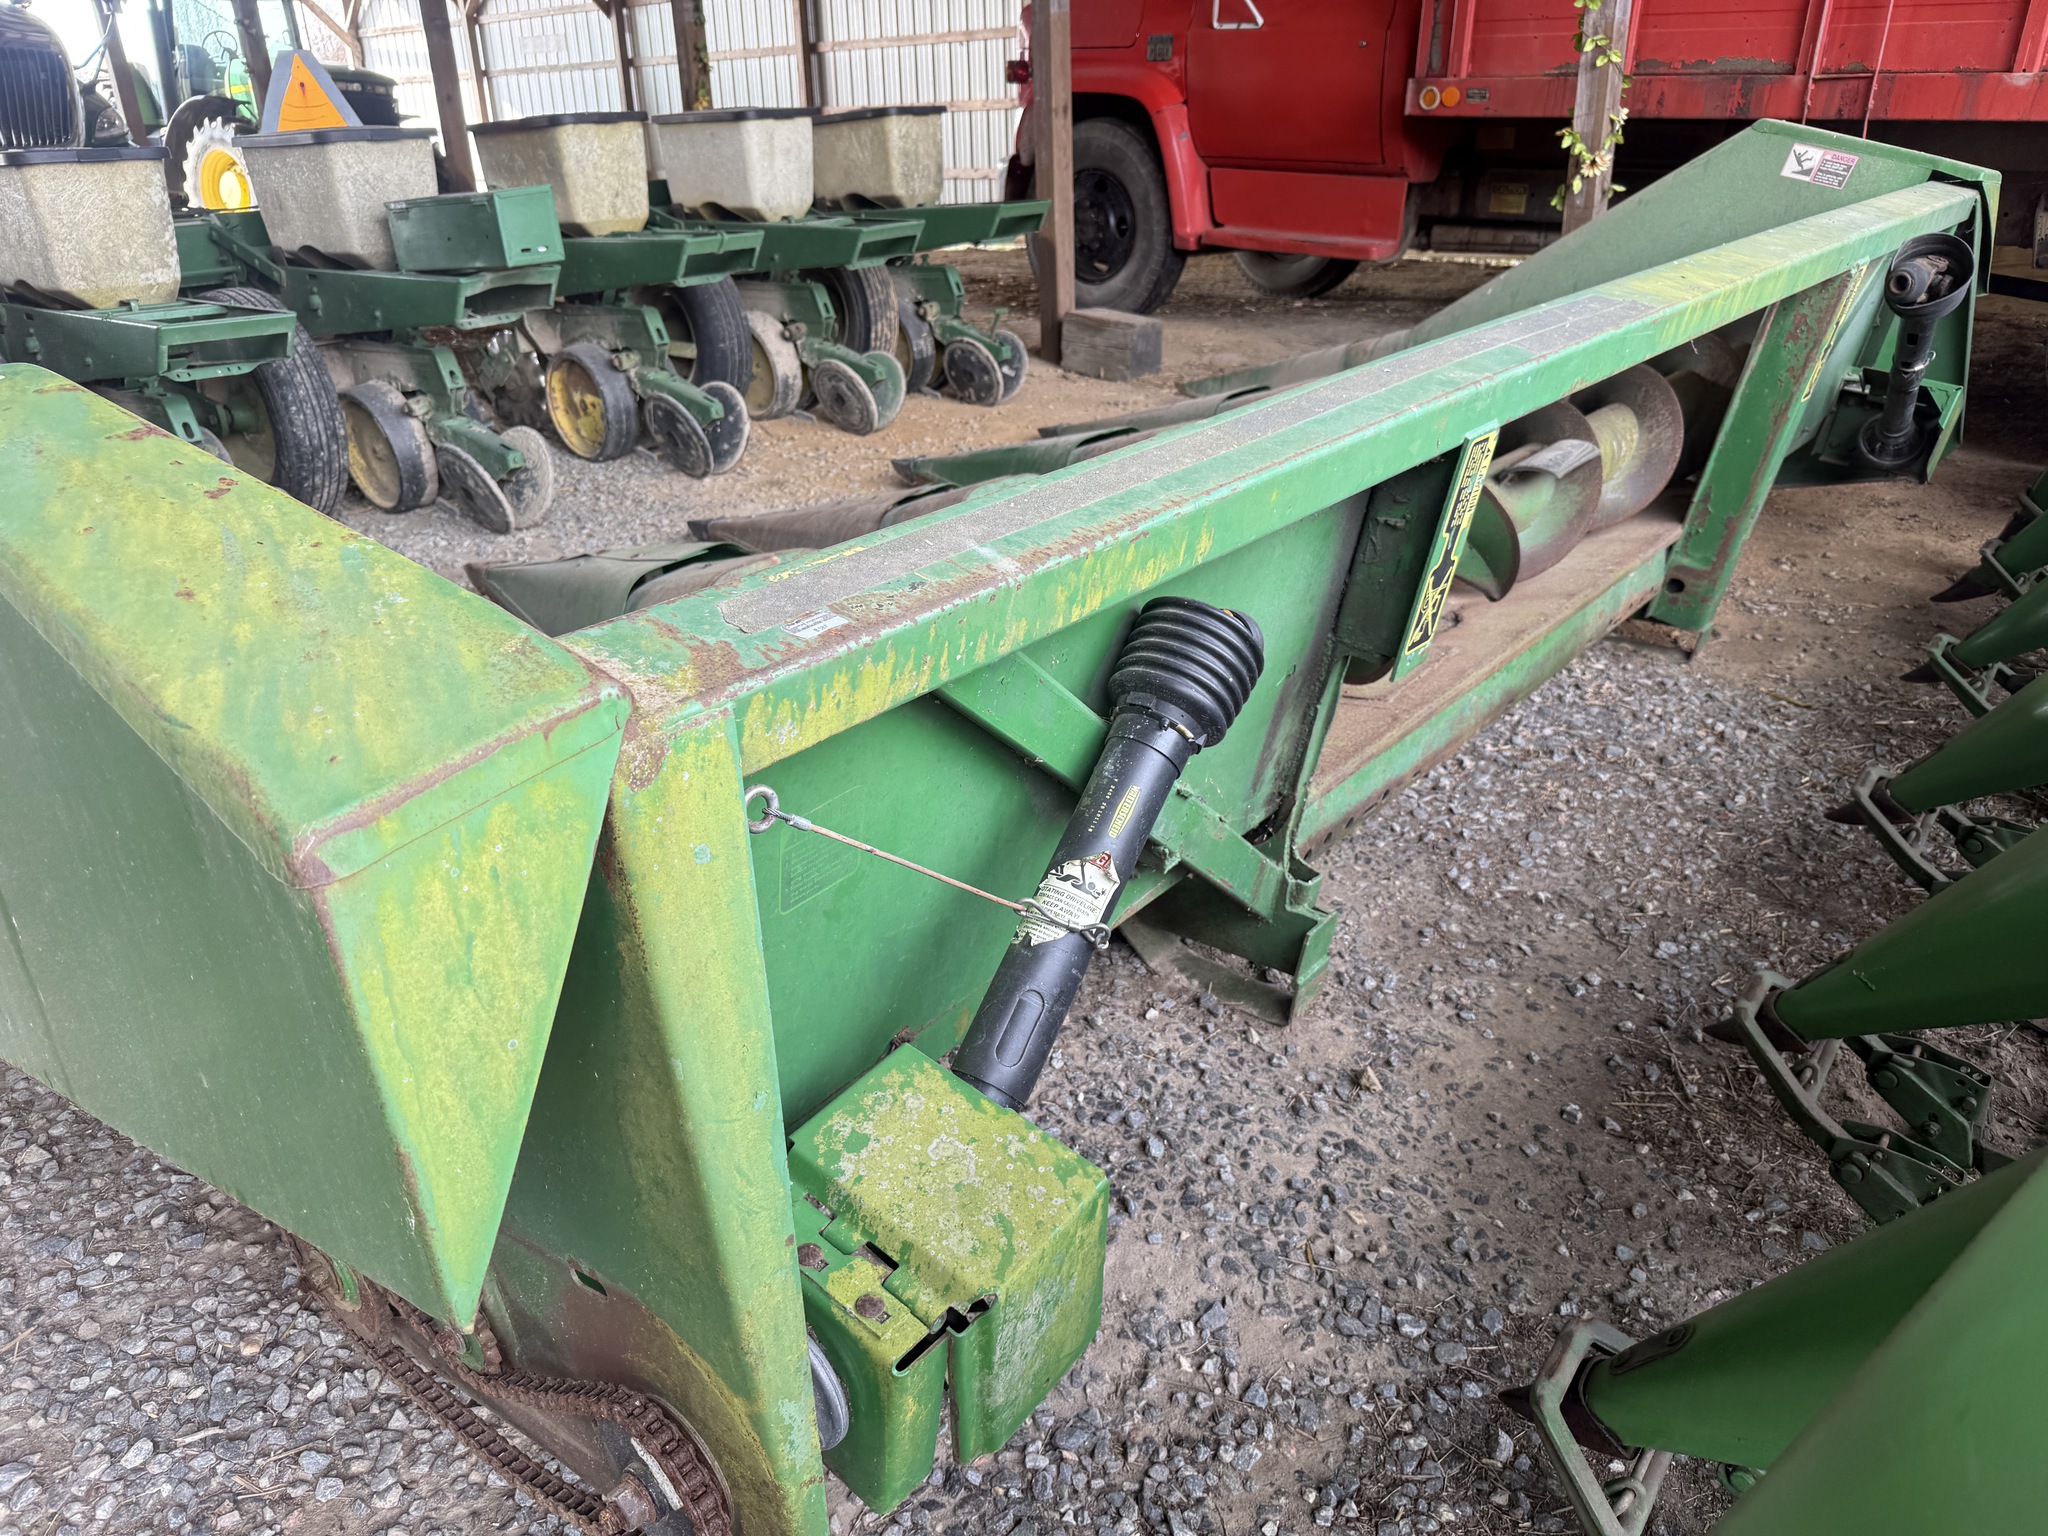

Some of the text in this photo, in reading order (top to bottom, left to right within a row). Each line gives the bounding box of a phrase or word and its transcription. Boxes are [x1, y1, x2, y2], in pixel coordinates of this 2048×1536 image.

[1831, 153, 1856, 164] DANGER
[1109, 785, 1141, 838] WALTERSCHEID
[1041, 900, 1081, 919] KEEP AWAY!
[1054, 896, 1064, 904] CAN
[1076, 907, 1090, 917] DEATH
